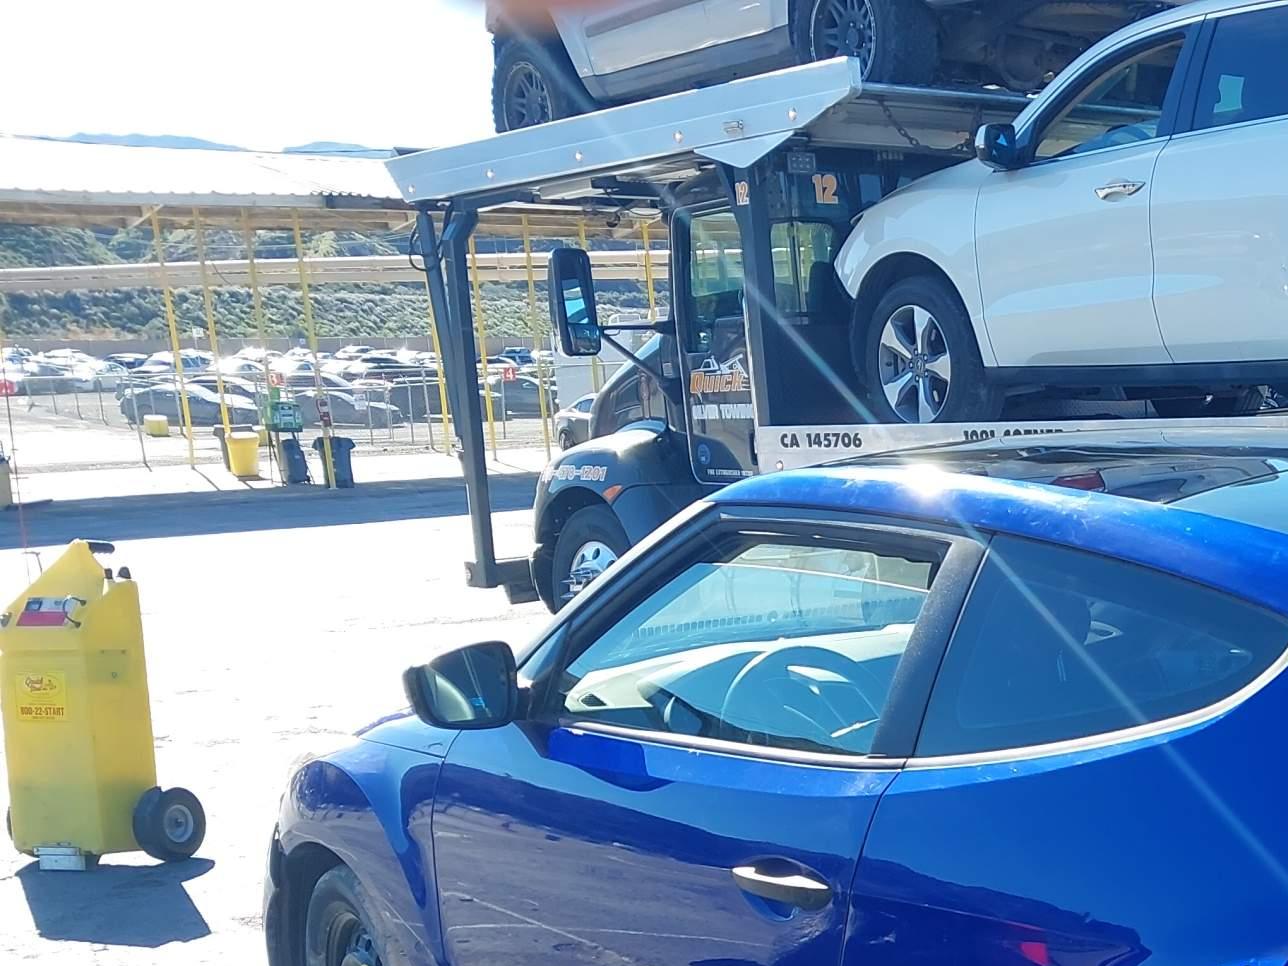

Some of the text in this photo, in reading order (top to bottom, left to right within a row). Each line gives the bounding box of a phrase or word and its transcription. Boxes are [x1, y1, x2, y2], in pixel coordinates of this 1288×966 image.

[735, 181, 749, 205] 12
[812, 174, 838, 204] 12
[780, 432, 862, 448] CA 145706
